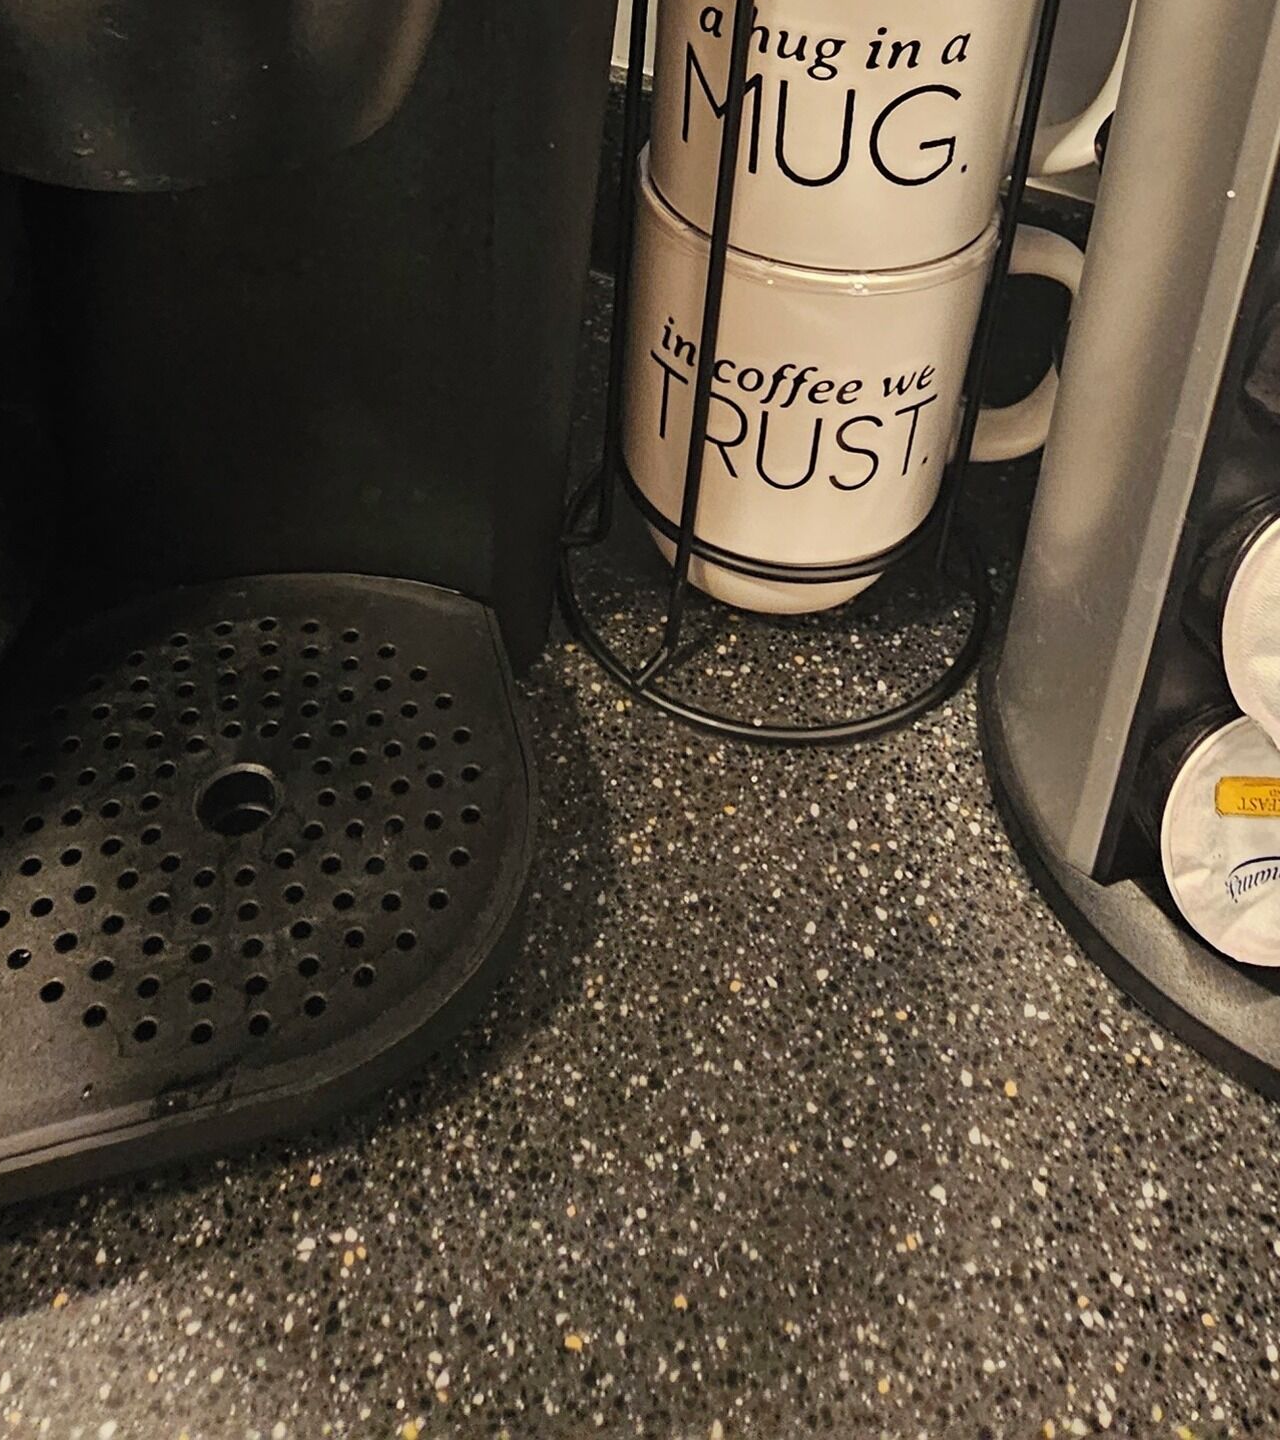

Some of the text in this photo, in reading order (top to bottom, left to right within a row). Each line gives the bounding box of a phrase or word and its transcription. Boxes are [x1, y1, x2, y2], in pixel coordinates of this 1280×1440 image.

[699, 5, 971, 81] a hug in a
[681, 41, 968, 187] MUG.
[661, 316, 936, 408] in coffee we
